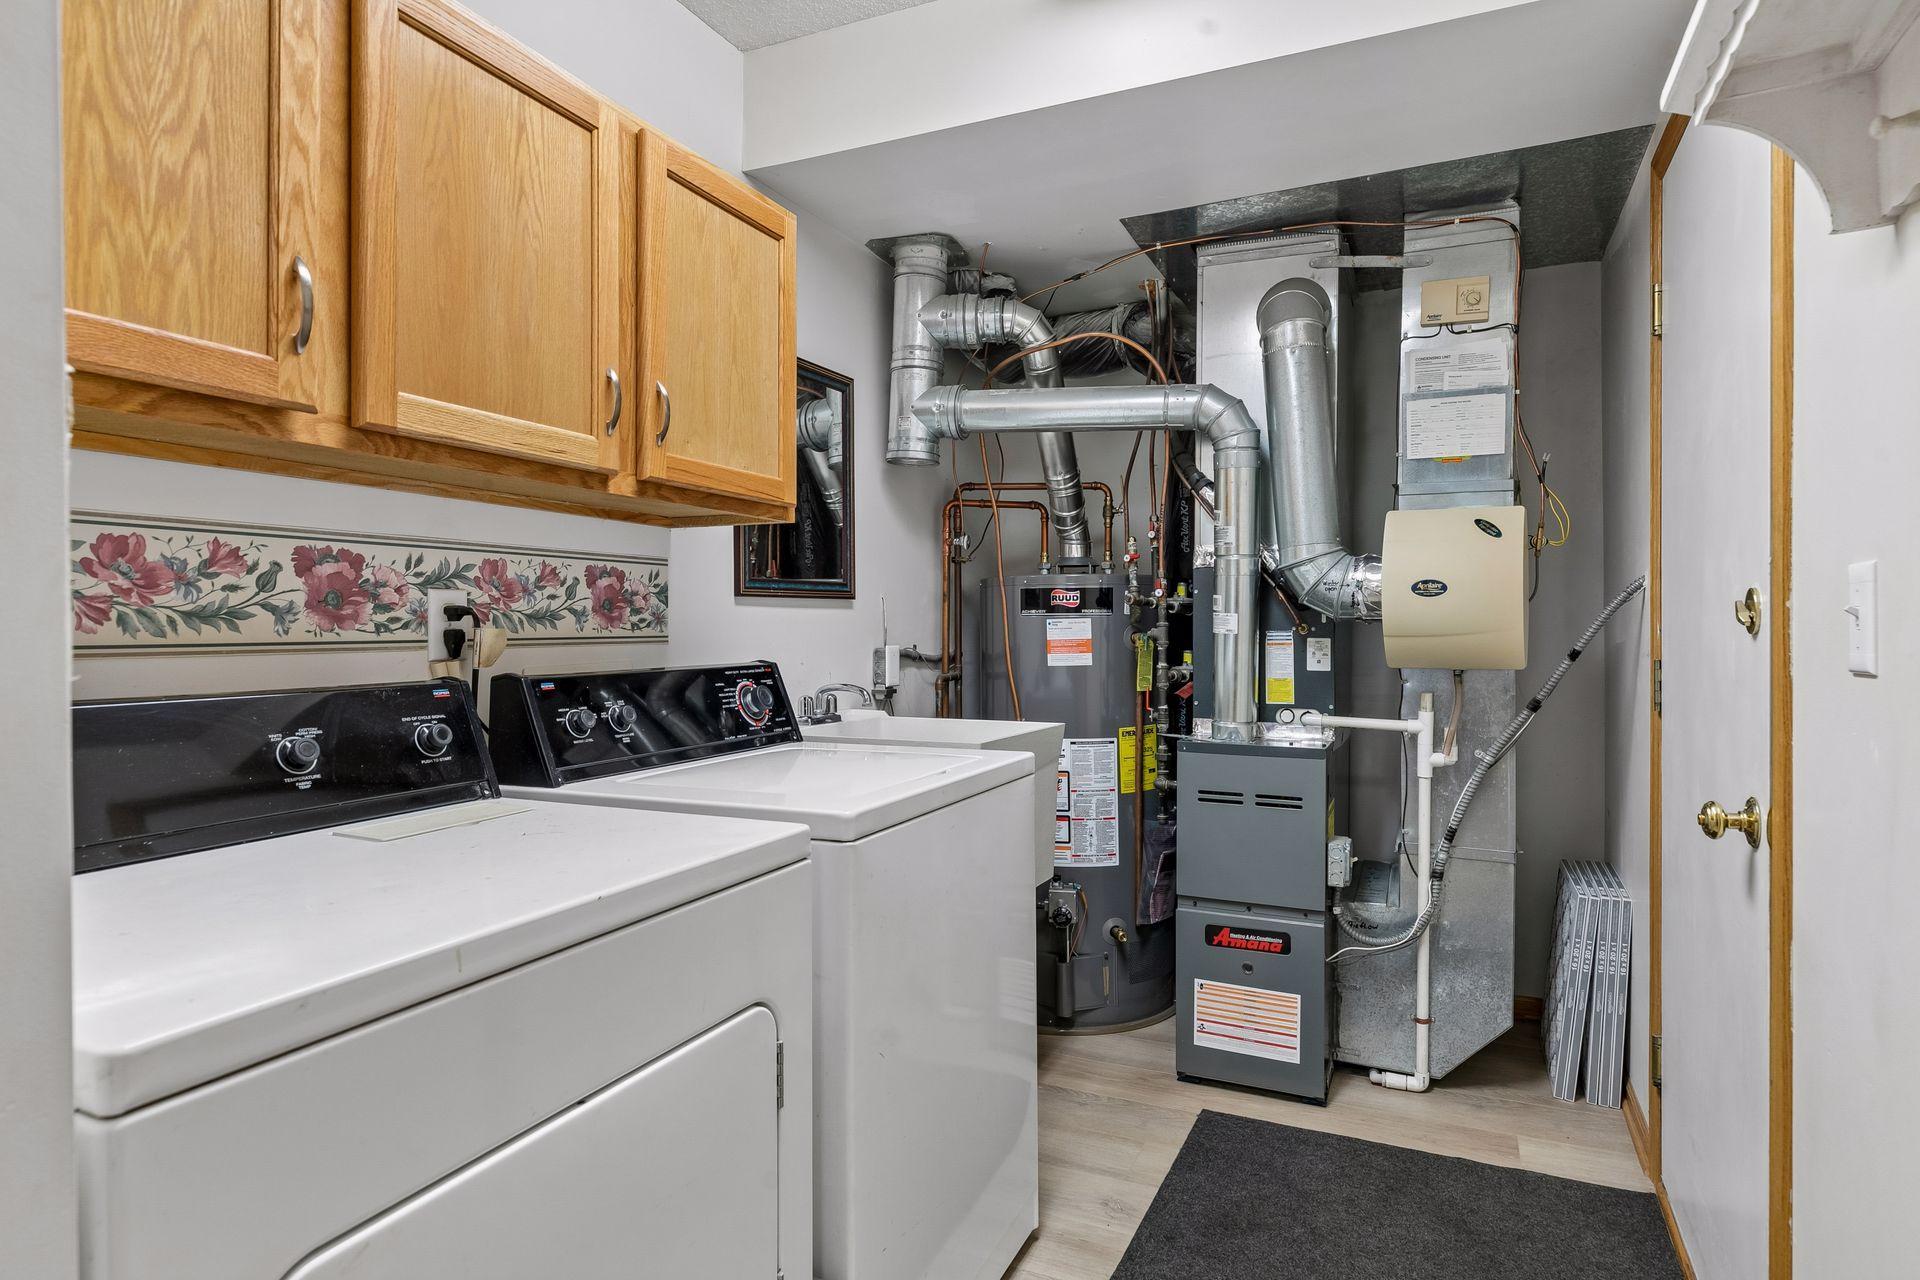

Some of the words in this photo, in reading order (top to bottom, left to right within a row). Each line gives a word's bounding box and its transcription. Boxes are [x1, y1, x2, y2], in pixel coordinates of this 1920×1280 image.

[1052, 594, 1079, 602] RUUD
[284, 774, 322, 783] TEMPERATURE
[1213, 928, 1283, 952] Amana
[1573, 948, 1579, 957] 20
[1584, 950, 1591, 959] 20
[1598, 950, 1605, 960] 20
[1609, 951, 1616, 961] 20
[1620, 952, 1627, 962] 20
[1571, 962, 1578, 970] 16
[1583, 964, 1589, 973] 16
[1597, 965, 1604, 973] 16
[1609, 966, 1615, 975] 16
[1620, 967, 1627, 976] 16
